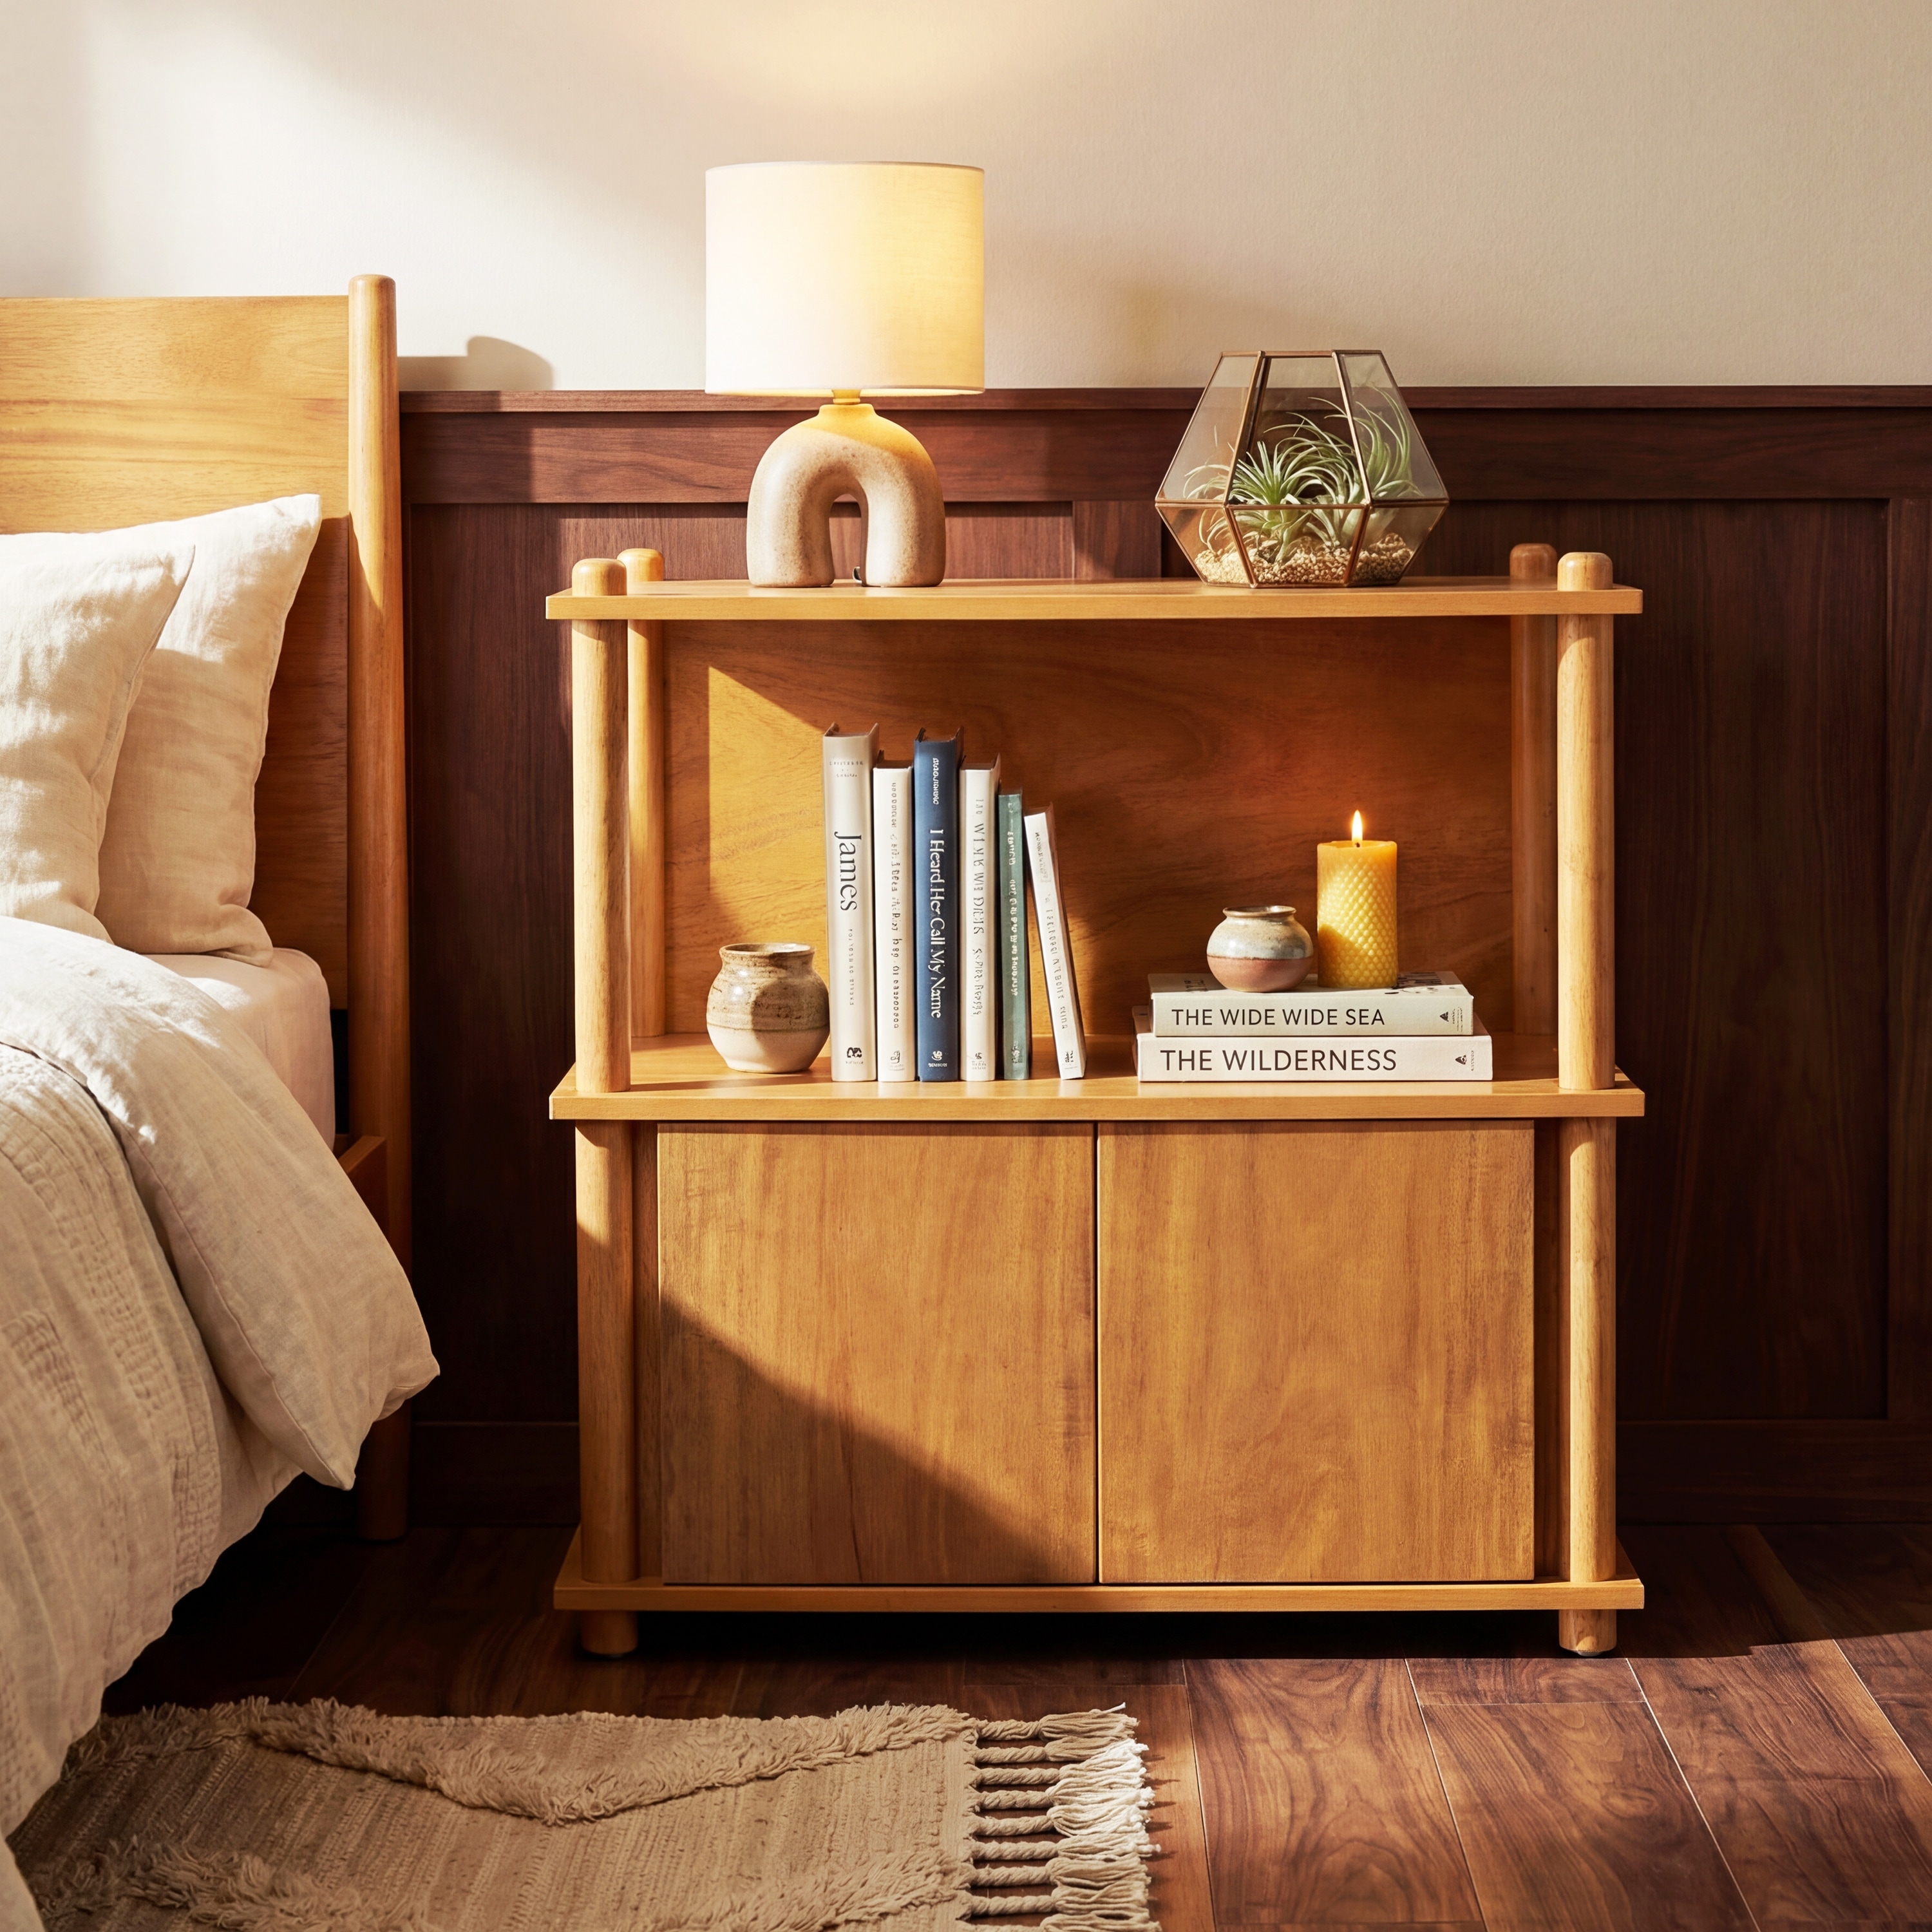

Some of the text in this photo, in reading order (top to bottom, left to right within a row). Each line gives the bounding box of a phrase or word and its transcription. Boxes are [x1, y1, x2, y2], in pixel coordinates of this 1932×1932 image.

[834, 831, 862, 911] James
[929, 839, 945, 883] Heard
[930, 917, 945, 945] Call
[927, 949, 945, 974] My
[930, 977, 945, 1018] Name
[1171, 1009, 1385, 1026] THE WIDE WIDE SEA
[1160, 1049, 1396, 1071] THE WILDERNESS
